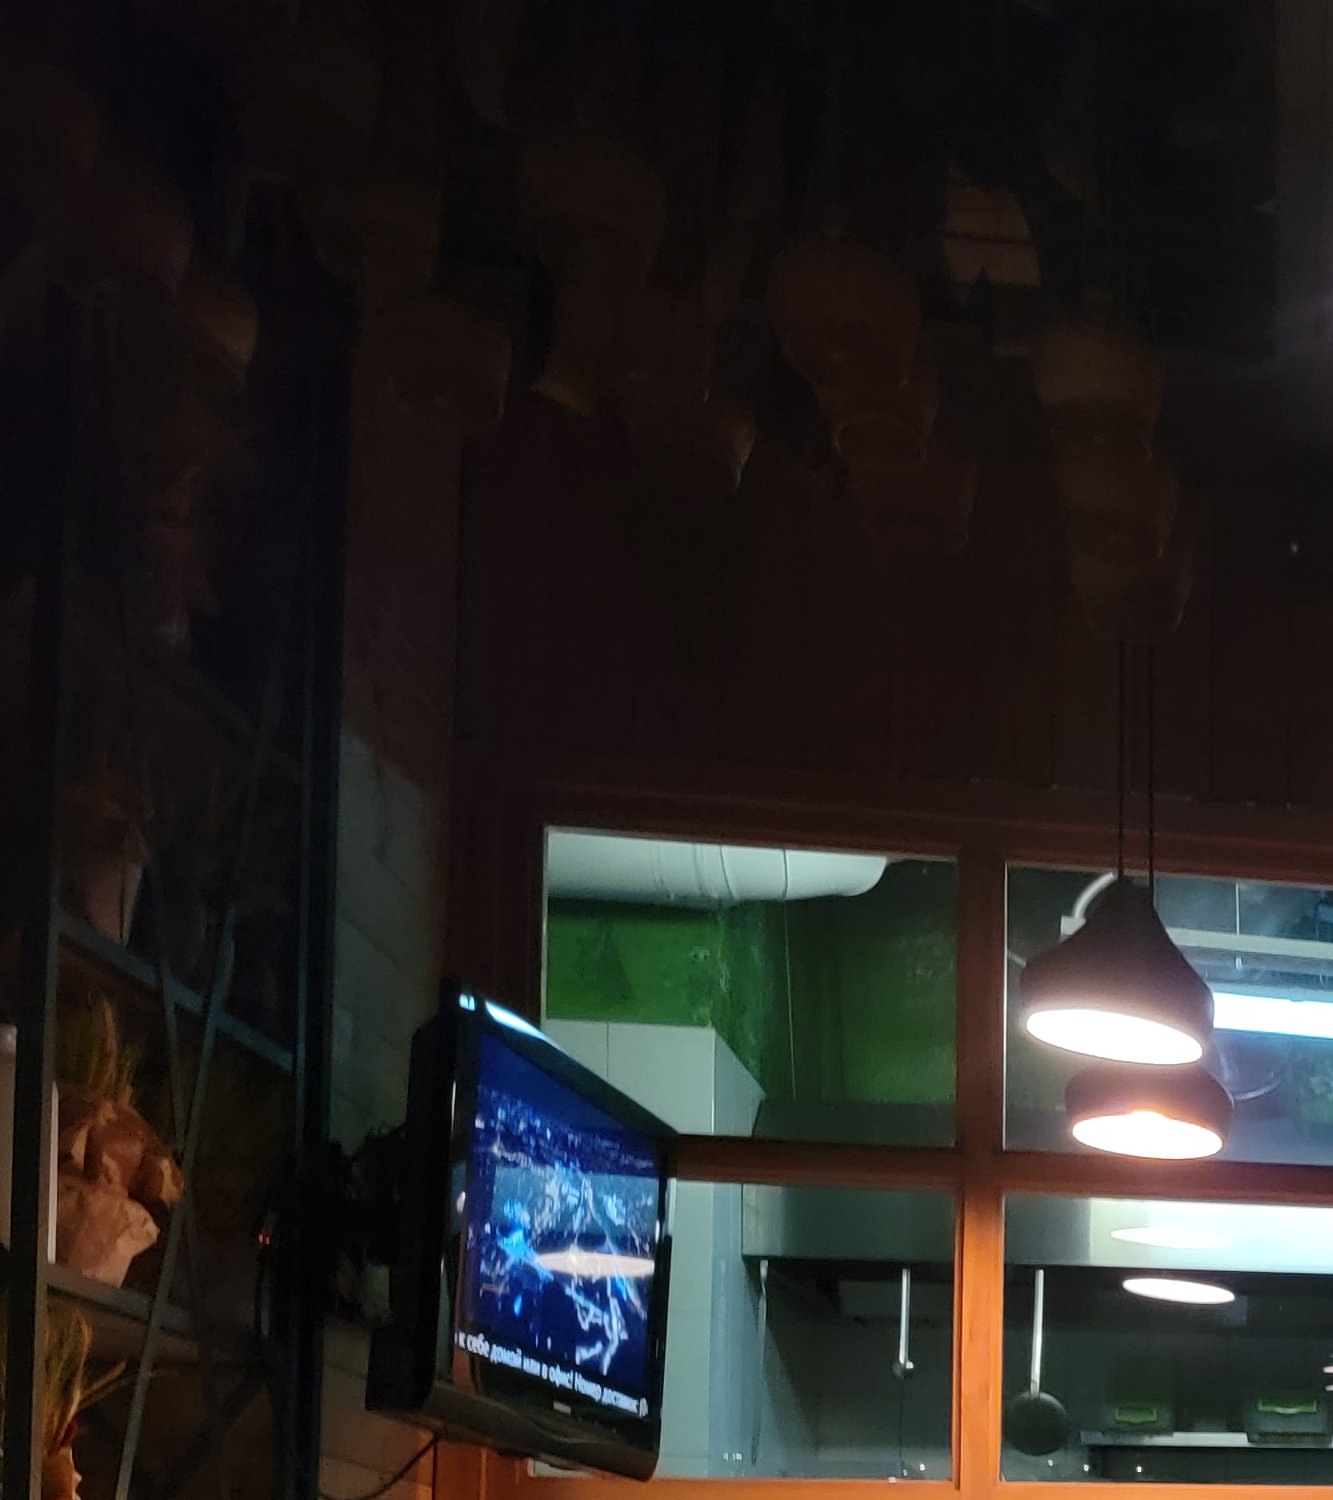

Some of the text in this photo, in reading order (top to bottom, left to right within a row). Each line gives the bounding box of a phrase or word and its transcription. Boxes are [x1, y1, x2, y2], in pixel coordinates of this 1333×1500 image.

[467, 1332, 490, 1358] себе
[490, 1343, 523, 1370] домой
[523, 1355, 541, 1377] или
